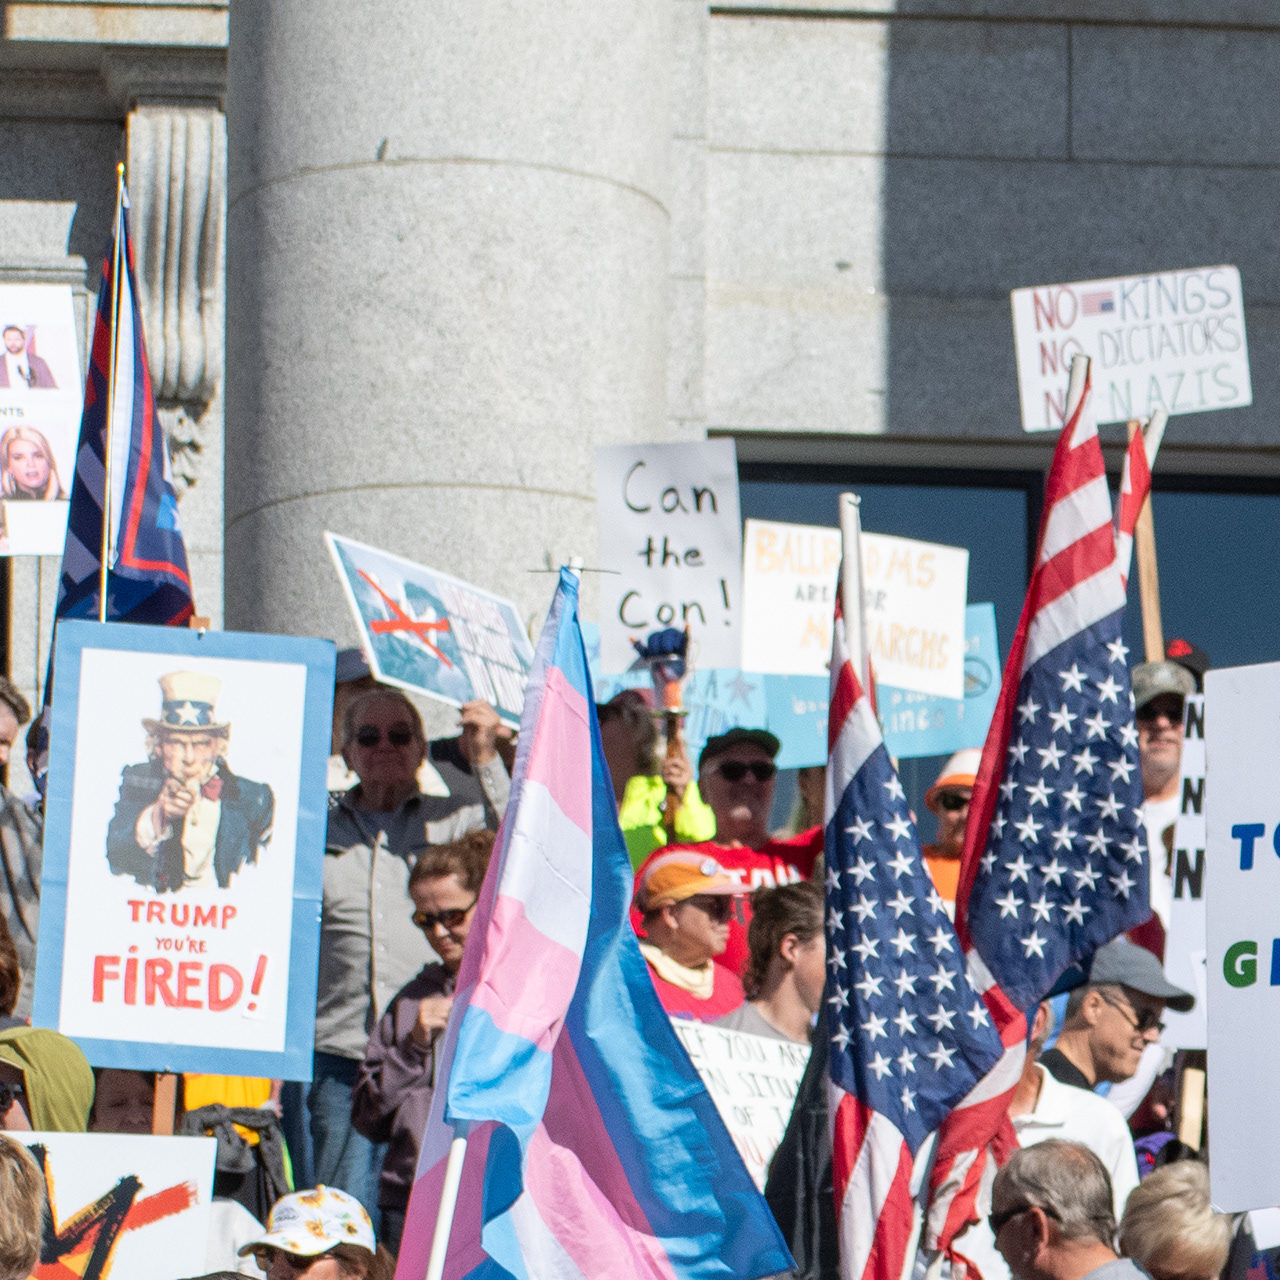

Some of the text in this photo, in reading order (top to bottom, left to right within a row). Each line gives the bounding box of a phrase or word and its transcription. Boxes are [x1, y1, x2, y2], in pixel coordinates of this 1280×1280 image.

[1032, 269, 1231, 332] NO KINGS
[1099, 314, 1242, 369] DICTATORS
[1109, 363, 1239, 420] NAZIS
[624, 461, 719, 514] Can
[637, 536, 706, 567] the
[619, 578, 732, 628] Con!
[127, 899, 238, 931] TRUMP
[155, 935, 208, 954] YOU'RE
